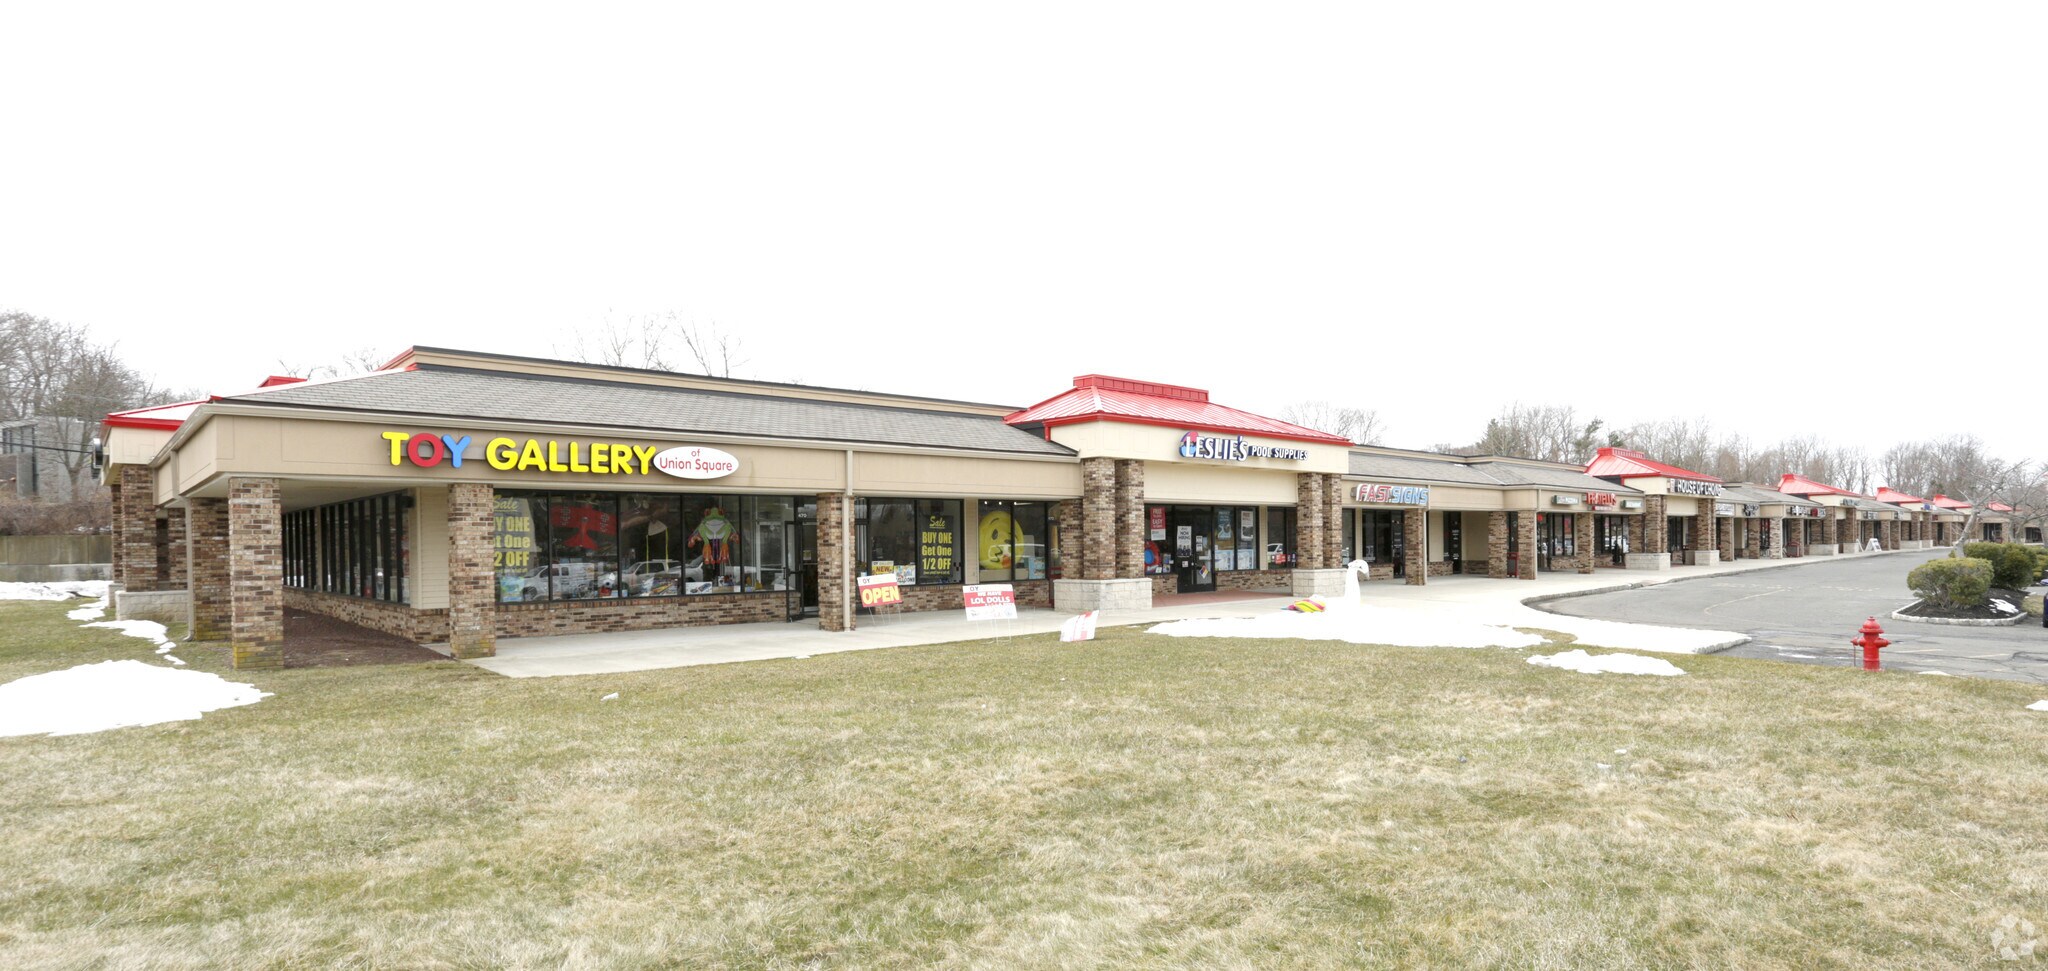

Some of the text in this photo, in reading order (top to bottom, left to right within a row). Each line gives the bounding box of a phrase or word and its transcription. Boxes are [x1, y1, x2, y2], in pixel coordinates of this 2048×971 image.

[381, 431, 657, 475] TOY GALLERY
[691, 448, 701, 457] of
[1185, 435, 1308, 461] LESLIE'S POOL SUPPLIES
[659, 456, 733, 473] Union Square
[1677, 479, 1697, 494] HOUSE
[1697, 481, 1705, 494] OF
[493, 494, 519, 511] Sale
[506, 516, 530, 532] ONE
[929, 516, 946, 528] Sale
[504, 534, 530, 548] One
[922, 531, 952, 544] BUY ONE
[922, 545, 952, 556] Get One
[505, 551, 530, 567] OFF
[922, 558, 951, 570] 1/2 OFF
[862, 586, 900, 605] OPEN
